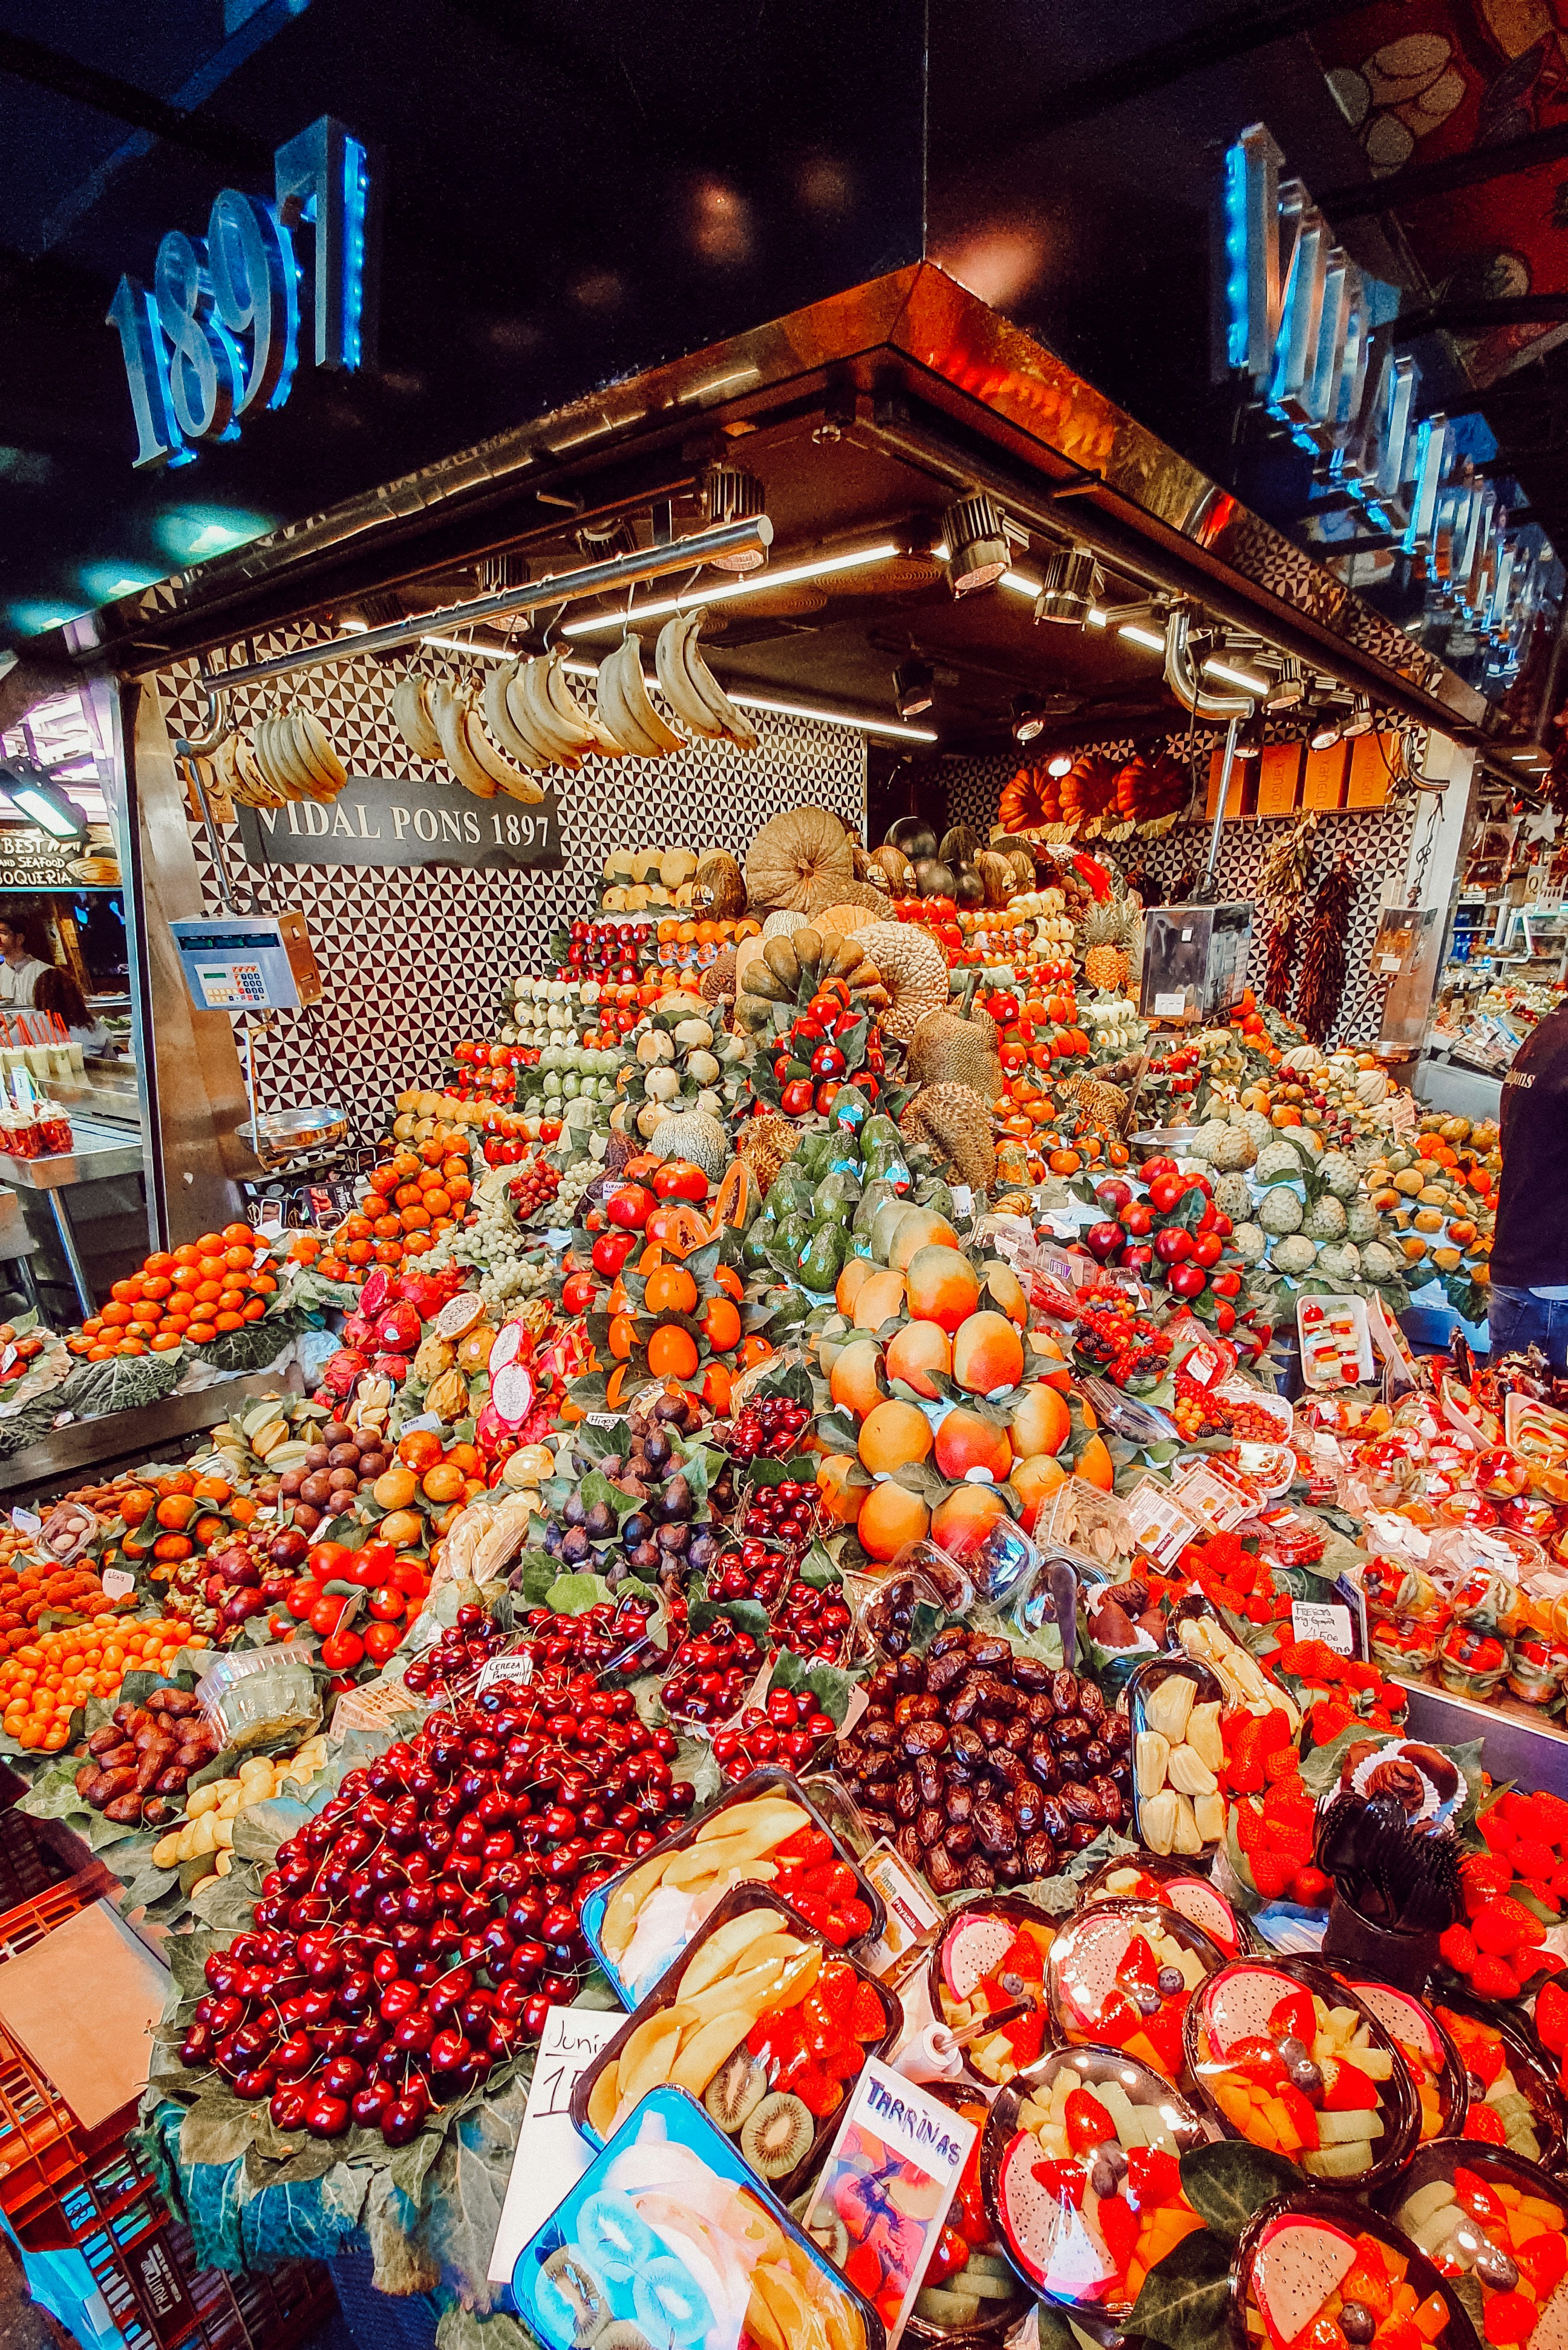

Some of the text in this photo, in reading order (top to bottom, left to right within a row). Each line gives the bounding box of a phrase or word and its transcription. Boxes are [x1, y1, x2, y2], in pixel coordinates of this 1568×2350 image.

[105, 114, 367, 468] 1897
[258, 799, 549, 847] VIDAL PONS 1897
[1, 837, 44, 854] BEST
[18, 856, 65, 869] SEAFOOD
[489, 1661, 520, 1671] CEREZA
[893, 1897, 917, 1930] Physalis
